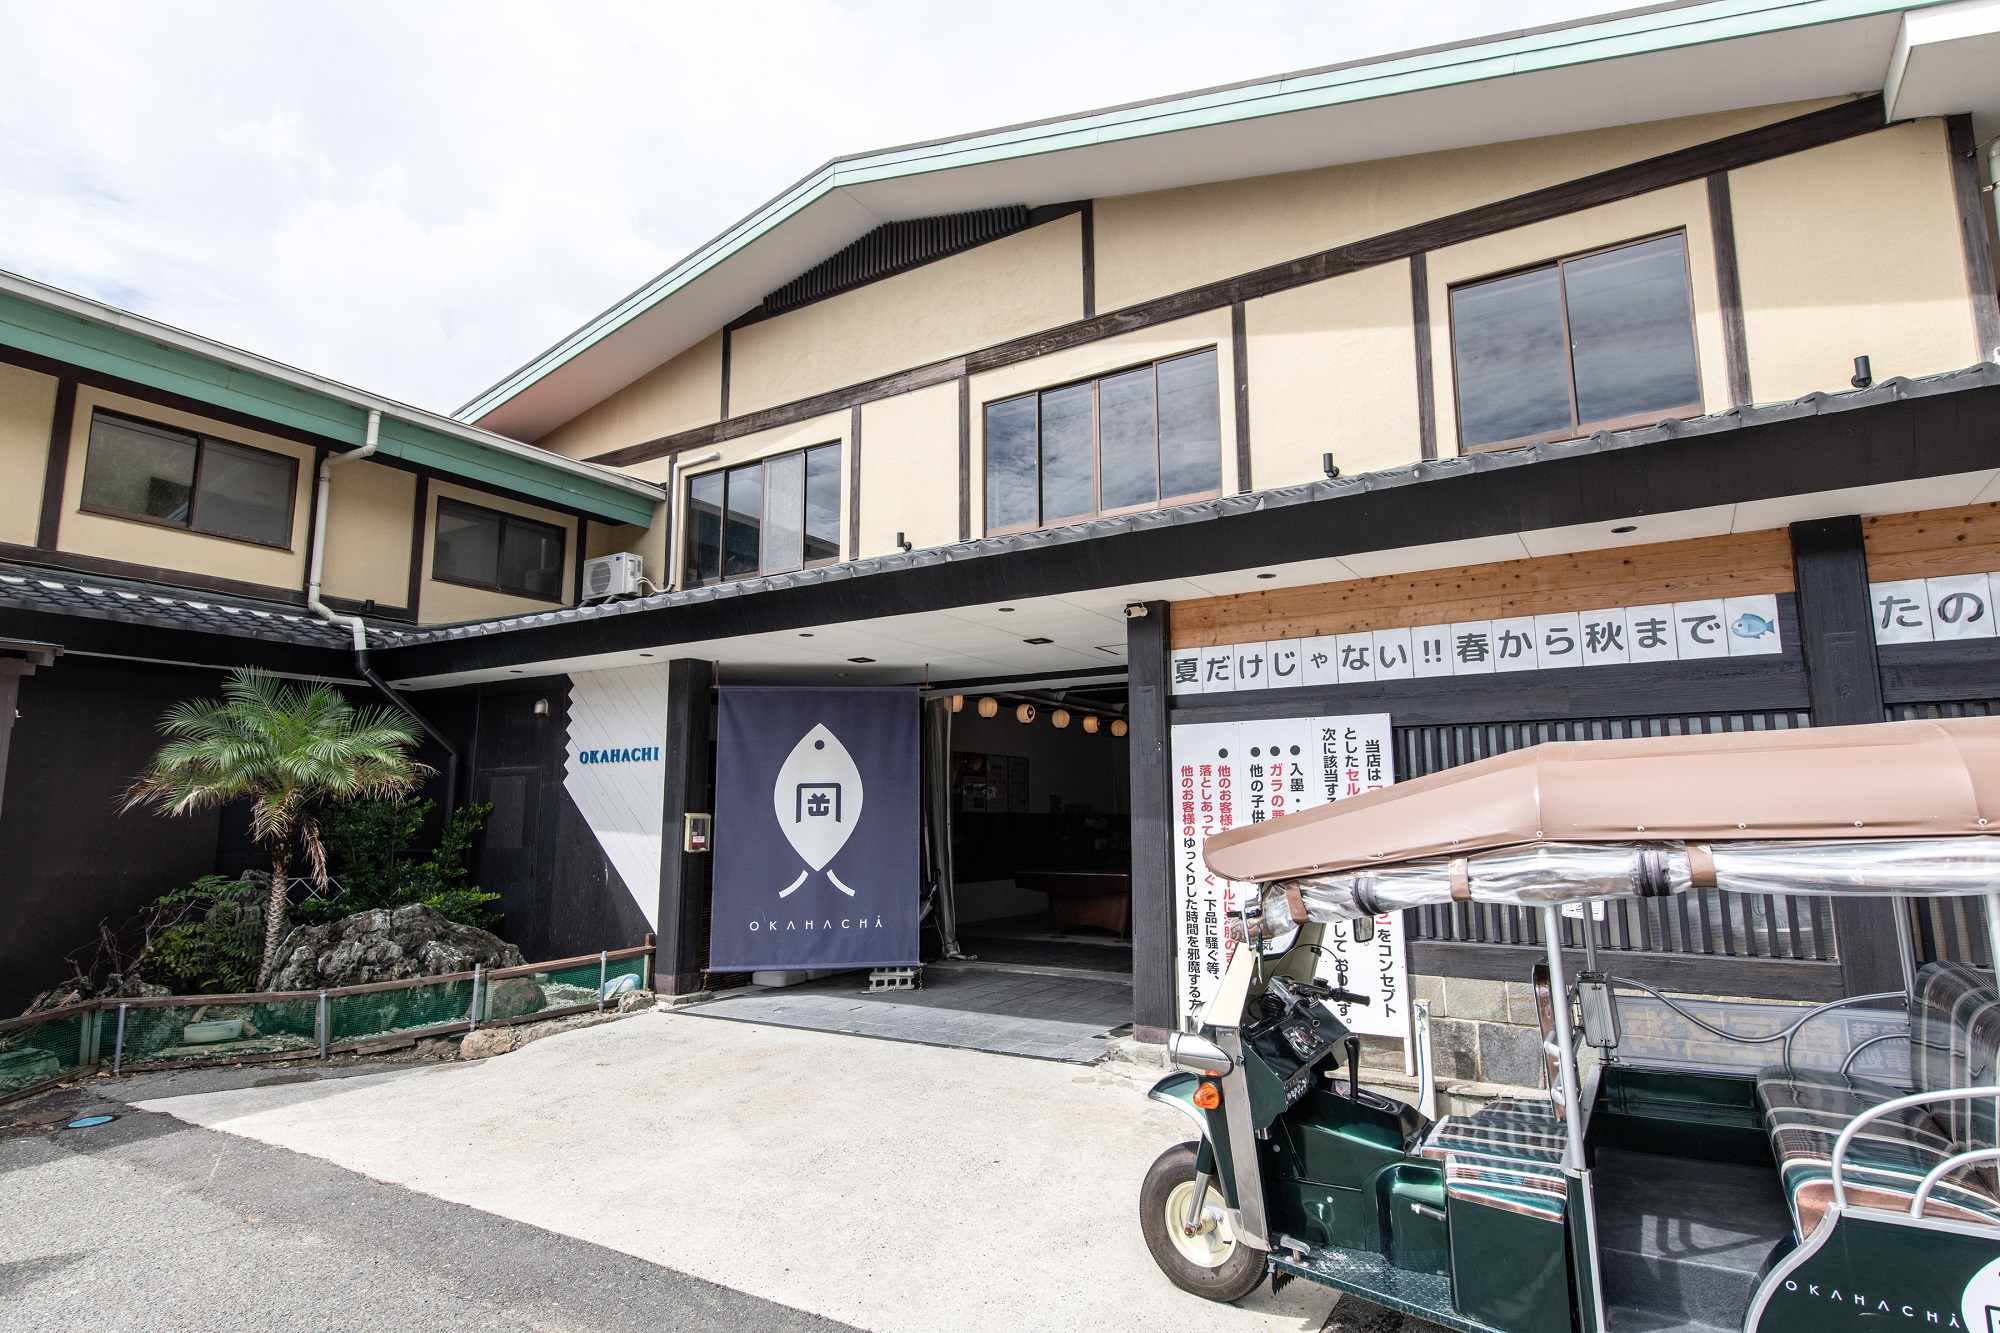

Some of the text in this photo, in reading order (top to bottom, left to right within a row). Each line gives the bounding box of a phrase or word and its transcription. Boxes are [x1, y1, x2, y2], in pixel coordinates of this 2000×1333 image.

[1879, 592, 1985, 630] たの
[579, 746, 660, 764] OKAHACHI
[1199, 764, 1214, 847] 落としあって
